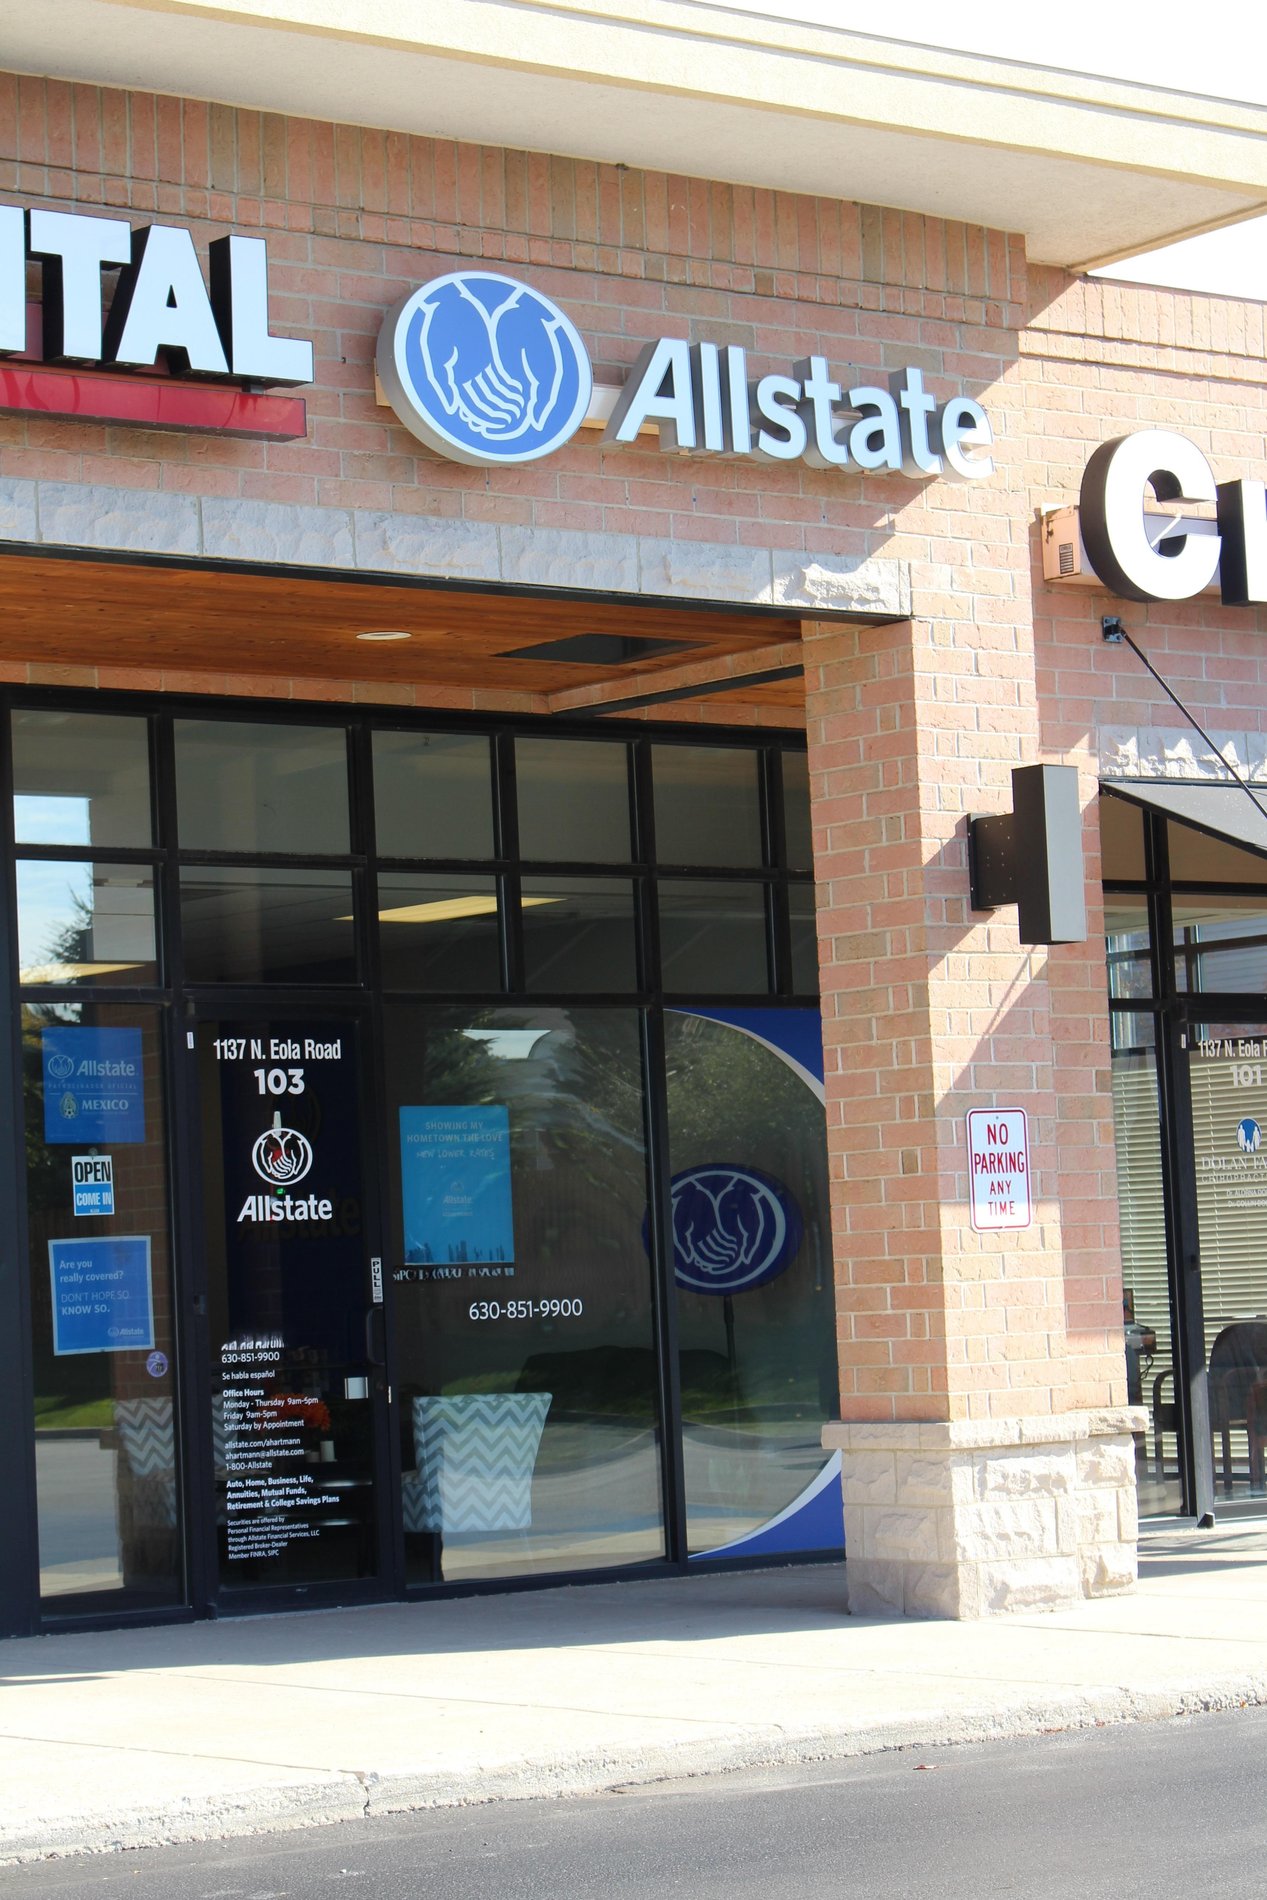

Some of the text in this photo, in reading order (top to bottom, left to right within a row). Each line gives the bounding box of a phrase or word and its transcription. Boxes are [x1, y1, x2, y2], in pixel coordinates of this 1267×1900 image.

[612, 337, 995, 480] Allstate
[213, 1039, 246, 1059] 1137
[251, 1039, 266, 1059] N.
[270, 1039, 300, 1059] Eola
[305, 1039, 341, 1059] Road
[1198, 1040, 1221, 1057] 1137
[1224, 1040, 1236, 1058] N.
[1238, 1040, 1260, 1058] Eola
[77, 1060, 135, 1076] Allstate
[254, 1068, 305, 1094] 103
[1230, 1065, 1262, 1087] 101
[82, 1099, 129, 1110] MEXICO
[425, 1121, 483, 1130] SHOWING MY
[407, 1134, 460, 1143] HOMETOWN
[987, 1123, 1008, 1145] NO
[974, 1151, 1024, 1175] PARKING
[74, 1161, 111, 1183] OPEN
[989, 1180, 1012, 1195] ANY
[76, 1191, 112, 1206] COME IN
[237, 1194, 333, 1222] Allstate
[988, 1200, 1015, 1216] TIME
[60, 1259, 92, 1271] Are you
[60, 1270, 124, 1283] really covered?
[373, 1261, 381, 1288] PULL
[91, 1290, 116, 1301] HOPE
[62, 1304, 110, 1315] KNOW SO.
[469, 1299, 583, 1320] 630-851-9900
[221, 1352, 280, 1363] 630-851-9900
[222, 1370, 275, 1380] Se habla español
[222, 1388, 264, 1398] Office Hours
[223, 1400, 250, 1410] Monday
[255, 1398, 285, 1408] Thursday
[287, 1397, 318, 1406] 9am-5pm
[223, 1410, 277, 1421] Friday 9am-5pm
[224, 1420, 304, 1432] Saturday by Appointment
[224, 1438, 300, 1449] allstate.com/ahartmann
[226, 1461, 272, 1470] 1-800-Allstate
[226, 1475, 313, 1489] Auto, Home, Business, Life,
[227, 1486, 307, 1500] Annuities, Mutual Funds,
[227, 1495, 339, 1511] Retirement & College Savings Plans
